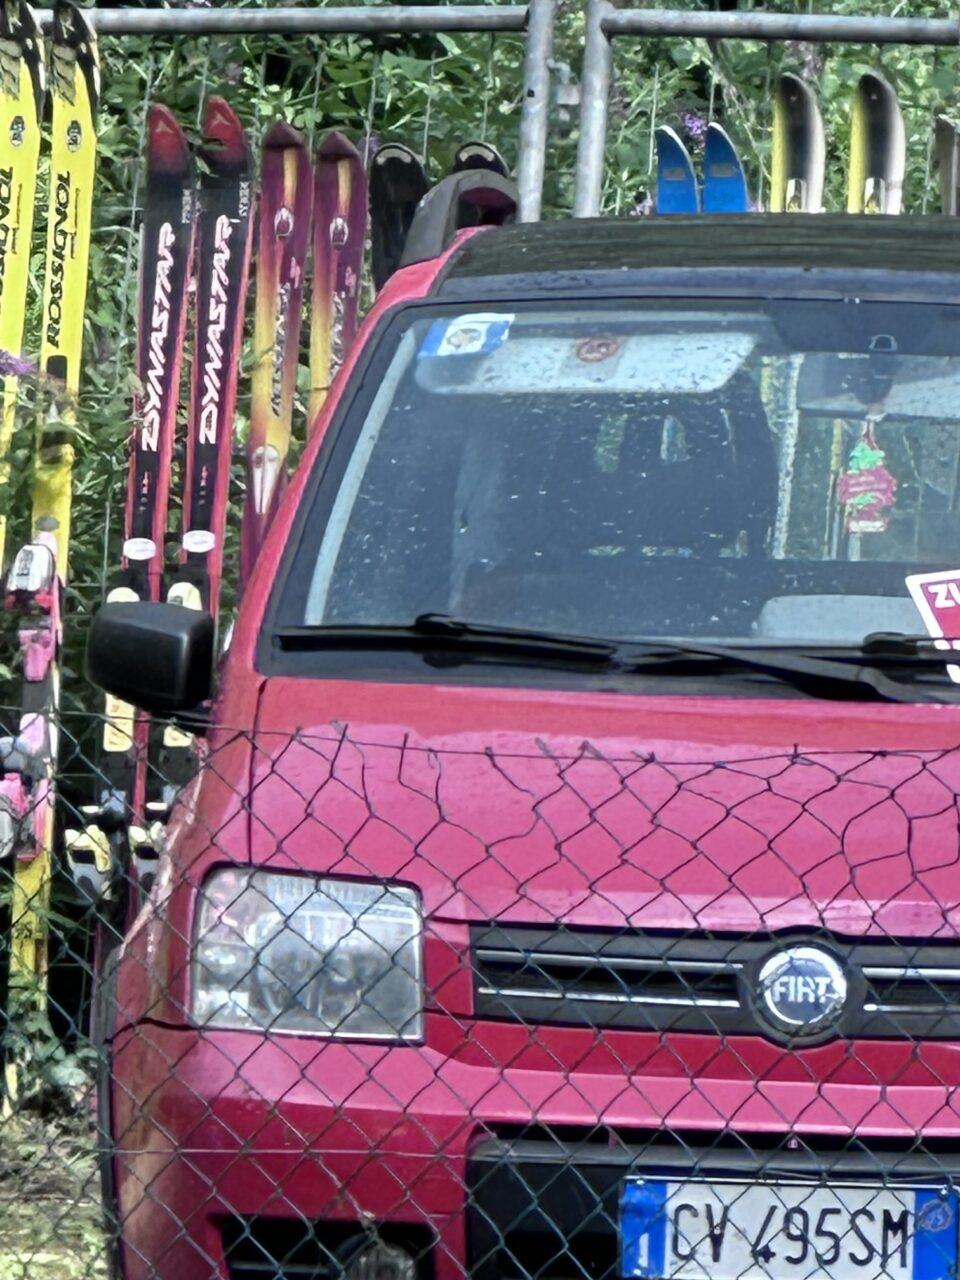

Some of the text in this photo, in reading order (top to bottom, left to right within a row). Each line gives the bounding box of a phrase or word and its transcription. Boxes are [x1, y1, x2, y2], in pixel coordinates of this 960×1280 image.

[46, 170, 72, 348] ROSSIGNOL
[141, 221, 176, 452] DYNASTAR
[199, 214, 233, 445] DYNASTAR
[771, 975, 832, 1004] FIAT
